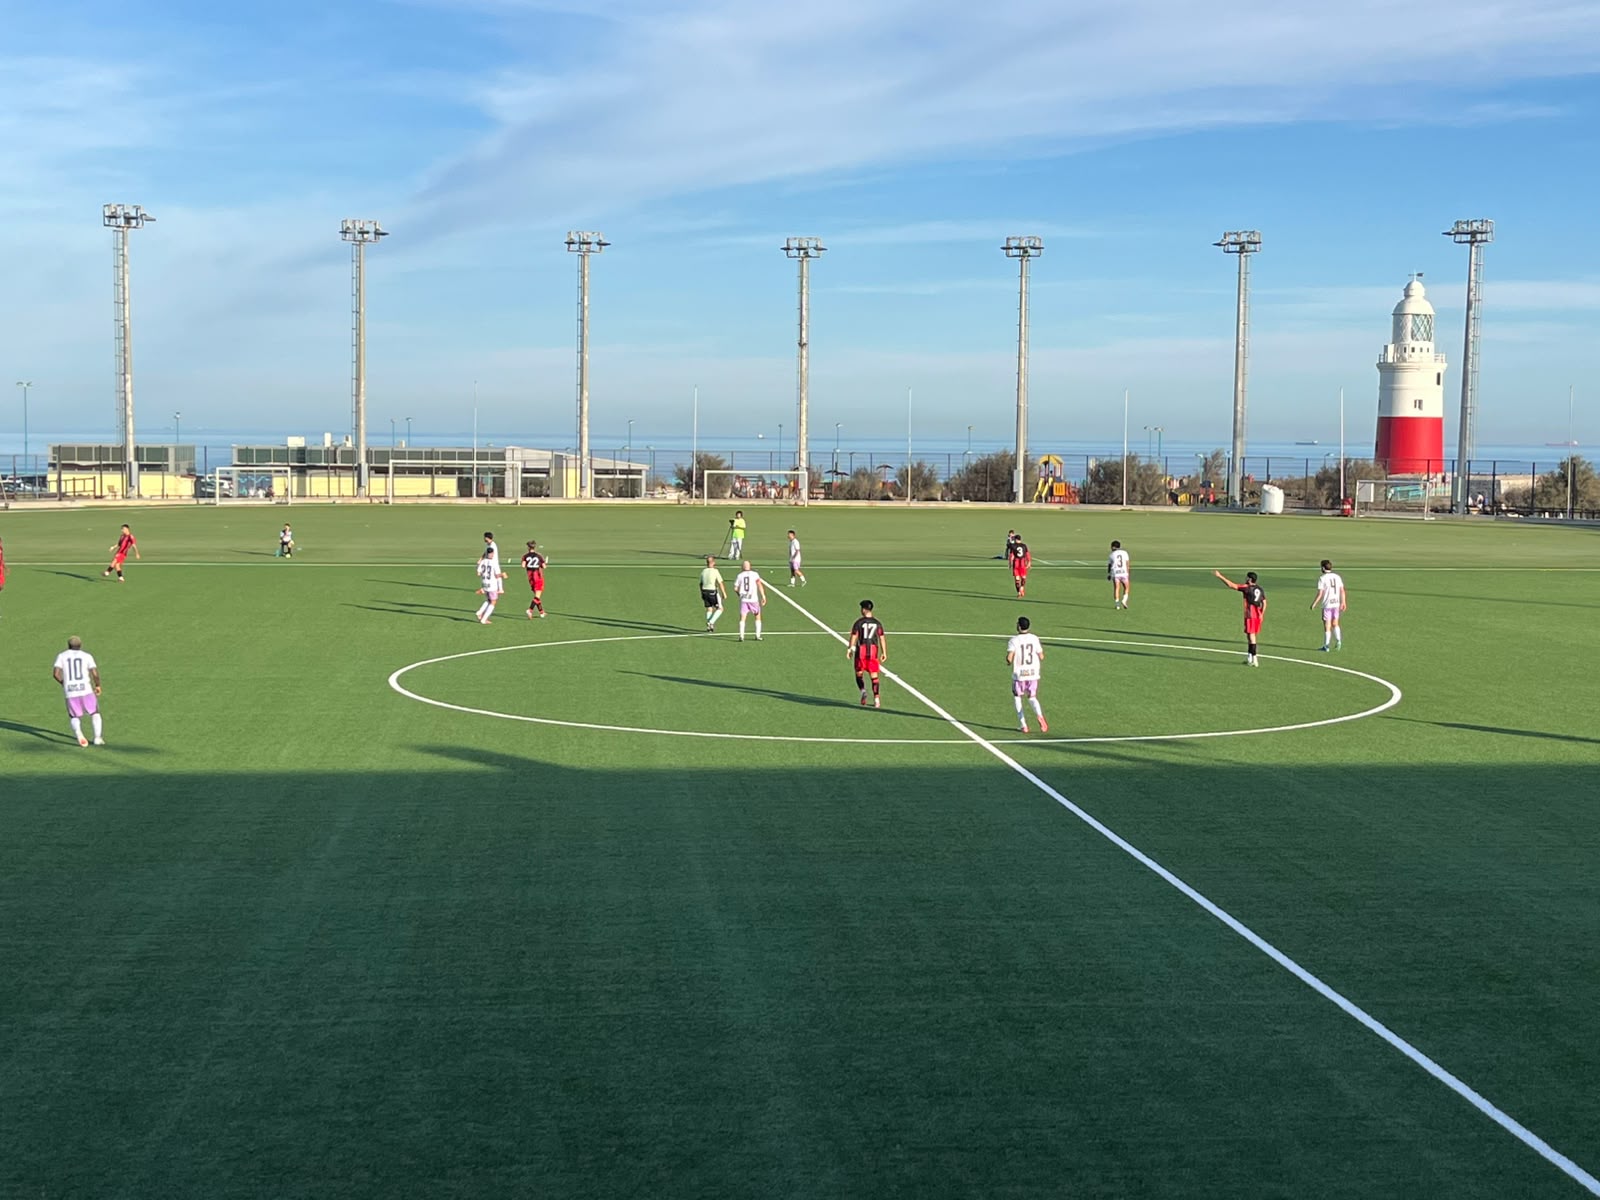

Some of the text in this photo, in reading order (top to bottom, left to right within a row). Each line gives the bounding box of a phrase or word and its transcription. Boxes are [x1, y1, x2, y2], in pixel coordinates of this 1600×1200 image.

[1016, 546, 1024, 557] 3
[525, 556, 540, 568] 22
[1116, 554, 1123, 568] 3
[480, 564, 492, 580] 23
[743, 576, 750, 592] 8
[1329, 577, 1337, 595] 4
[1254, 588, 1261, 602] 9
[861, 622, 878, 639] 17
[1020, 643, 1034, 666] 13
[66, 657, 83, 681] 10
